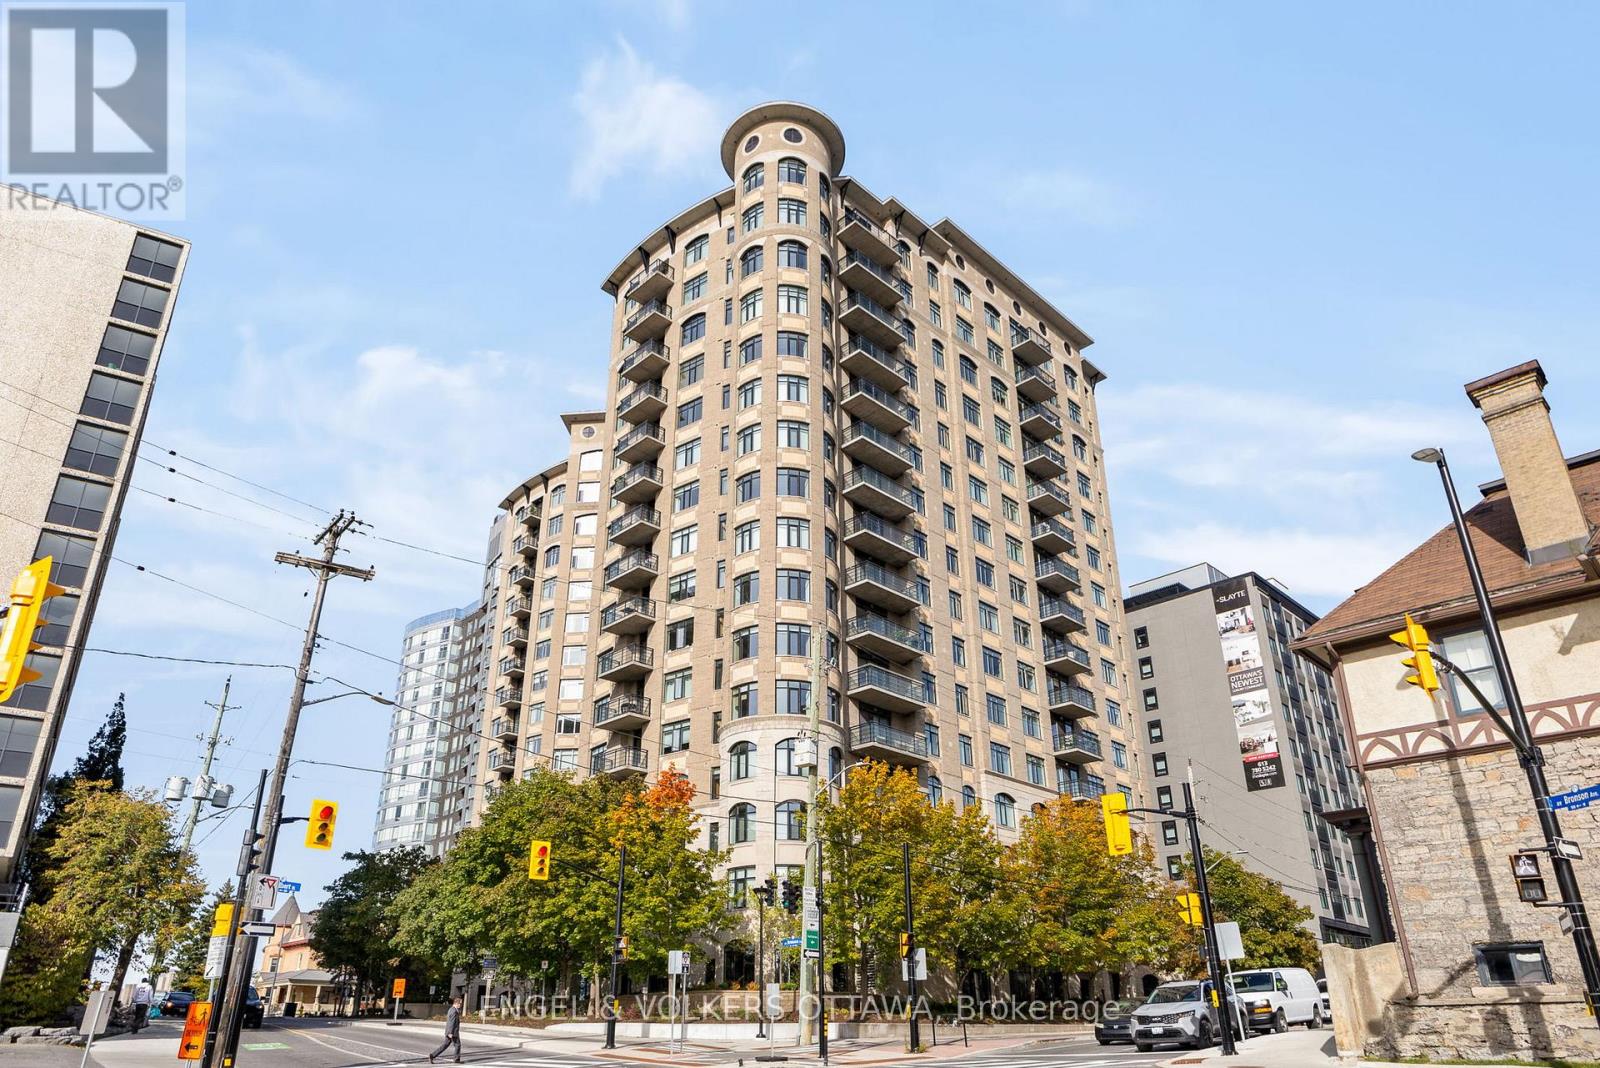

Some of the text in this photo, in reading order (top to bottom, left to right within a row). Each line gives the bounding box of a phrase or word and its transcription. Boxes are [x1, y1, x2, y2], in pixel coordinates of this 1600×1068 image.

[1219, 590, 1246, 603] SLAYTE
[1231, 676, 1264, 689] NEWEST
[1563, 793, 1588, 804] Bronson
